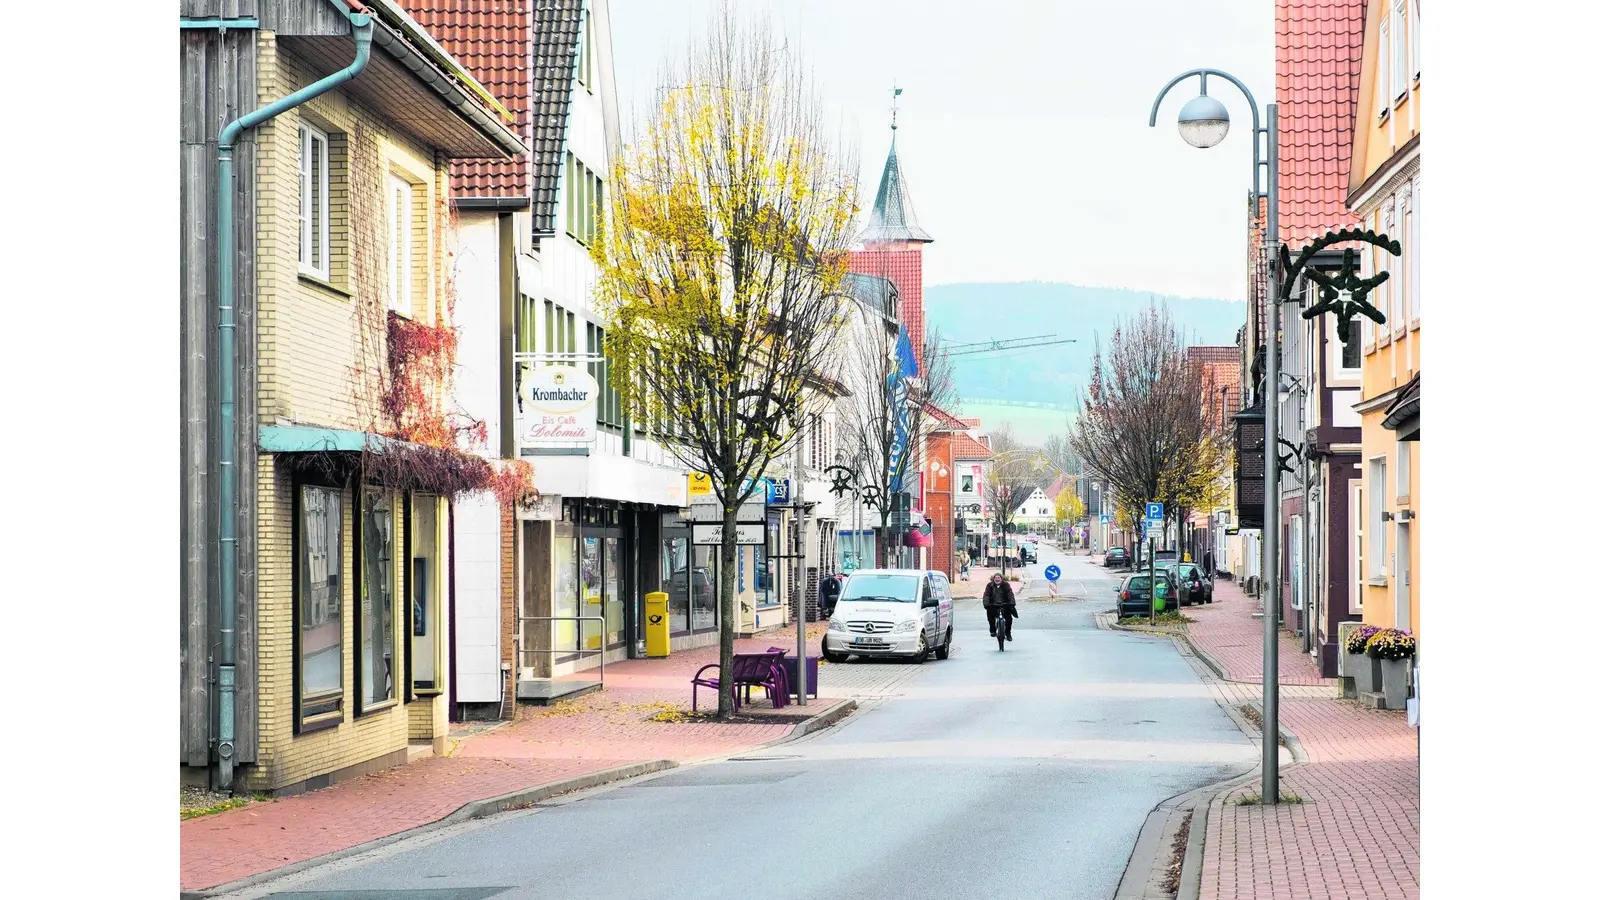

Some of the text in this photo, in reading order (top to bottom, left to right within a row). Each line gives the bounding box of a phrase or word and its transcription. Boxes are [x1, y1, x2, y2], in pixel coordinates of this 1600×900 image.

[533, 388, 588, 401] Krombacher
[542, 416, 555, 424] Eis
[530, 423, 588, 438] Dolomiti
[1150, 505, 1159, 518] P
